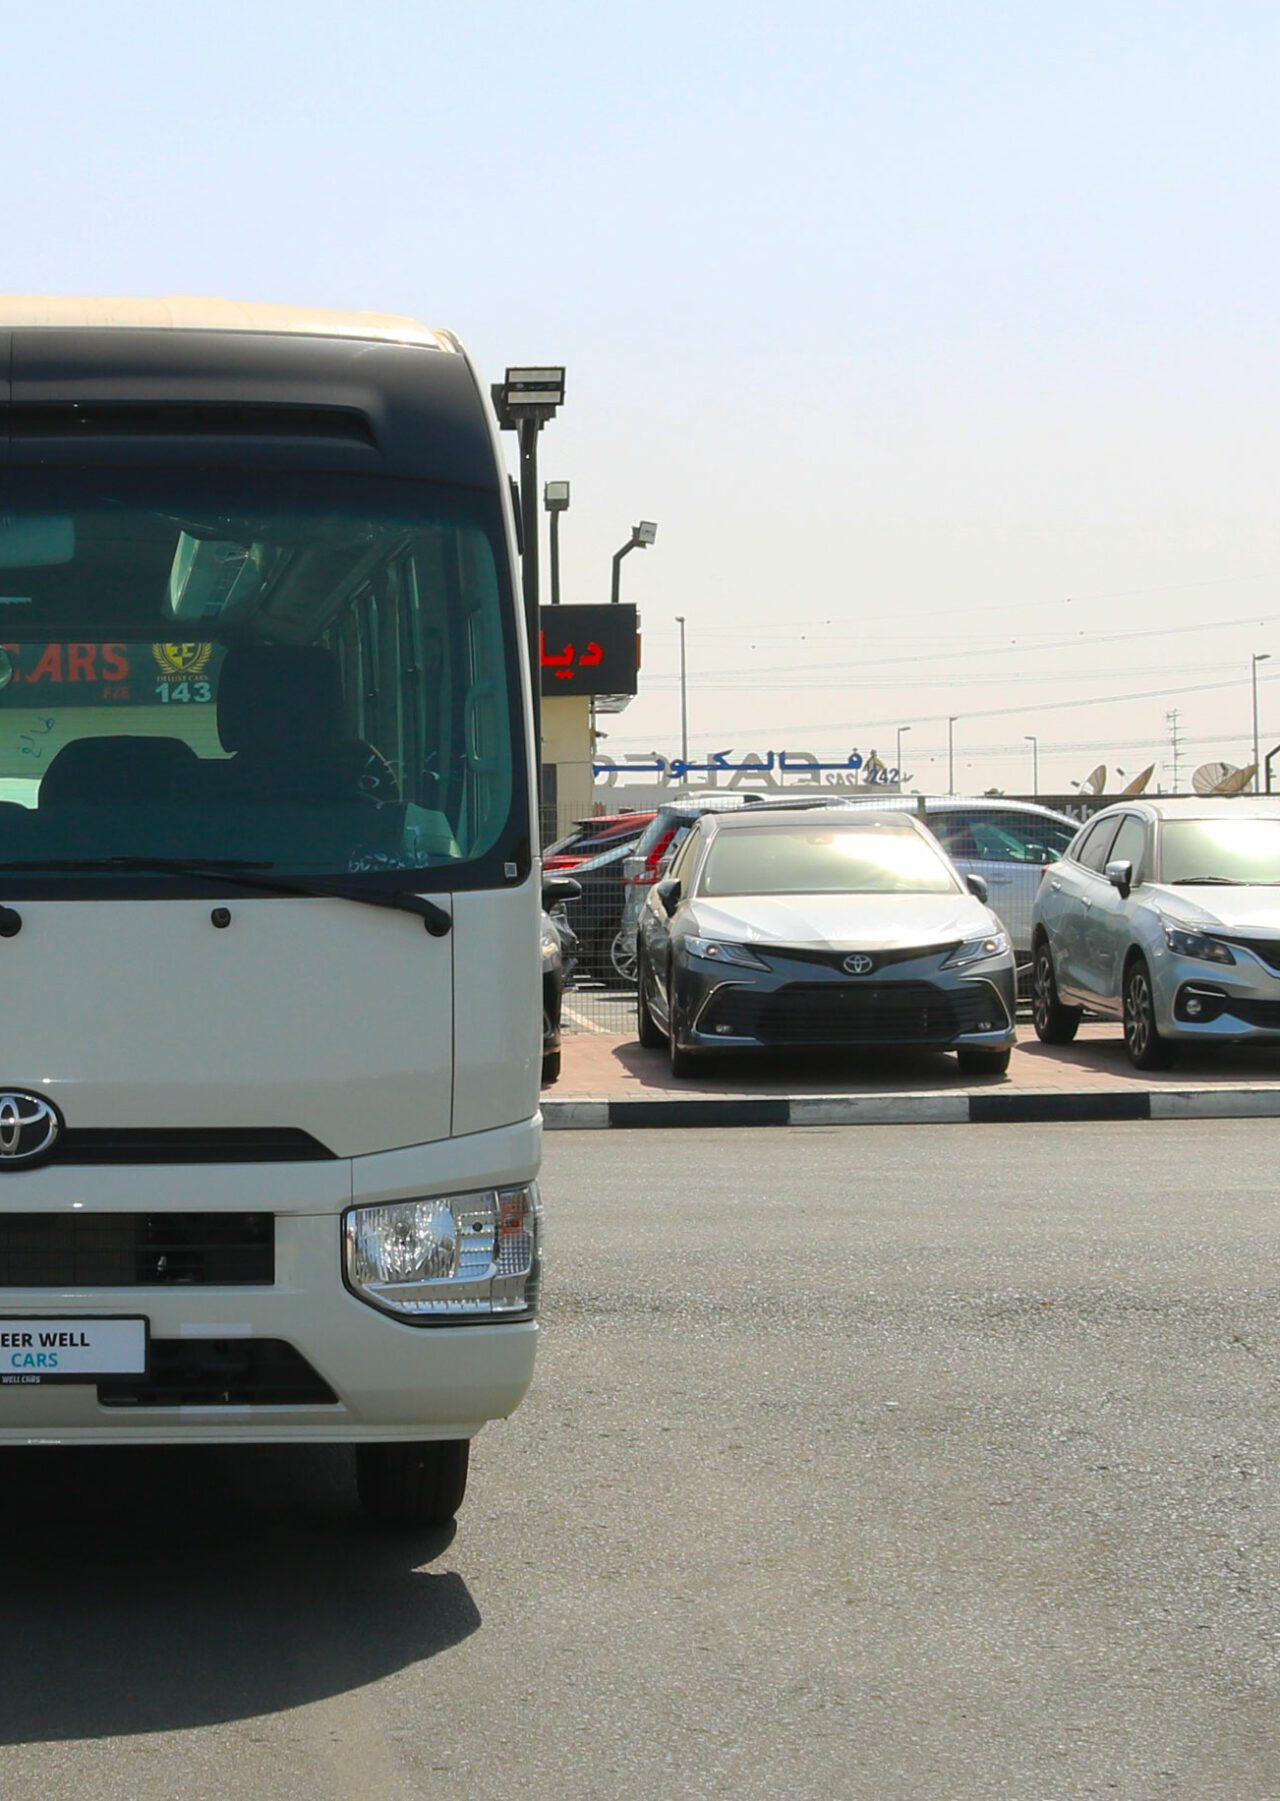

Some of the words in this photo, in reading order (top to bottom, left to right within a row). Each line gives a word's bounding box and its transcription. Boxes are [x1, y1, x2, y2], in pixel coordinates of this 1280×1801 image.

[4, 643, 130, 684] ARS
[155, 681, 211, 703] 143
[869, 768, 900, 785] 242
[38, 1332, 91, 1347] WELL
[10, 1352, 59, 1368] CARS
[1, 1375, 20, 1384] WELL
[20, 1375, 41, 1384] CARS
